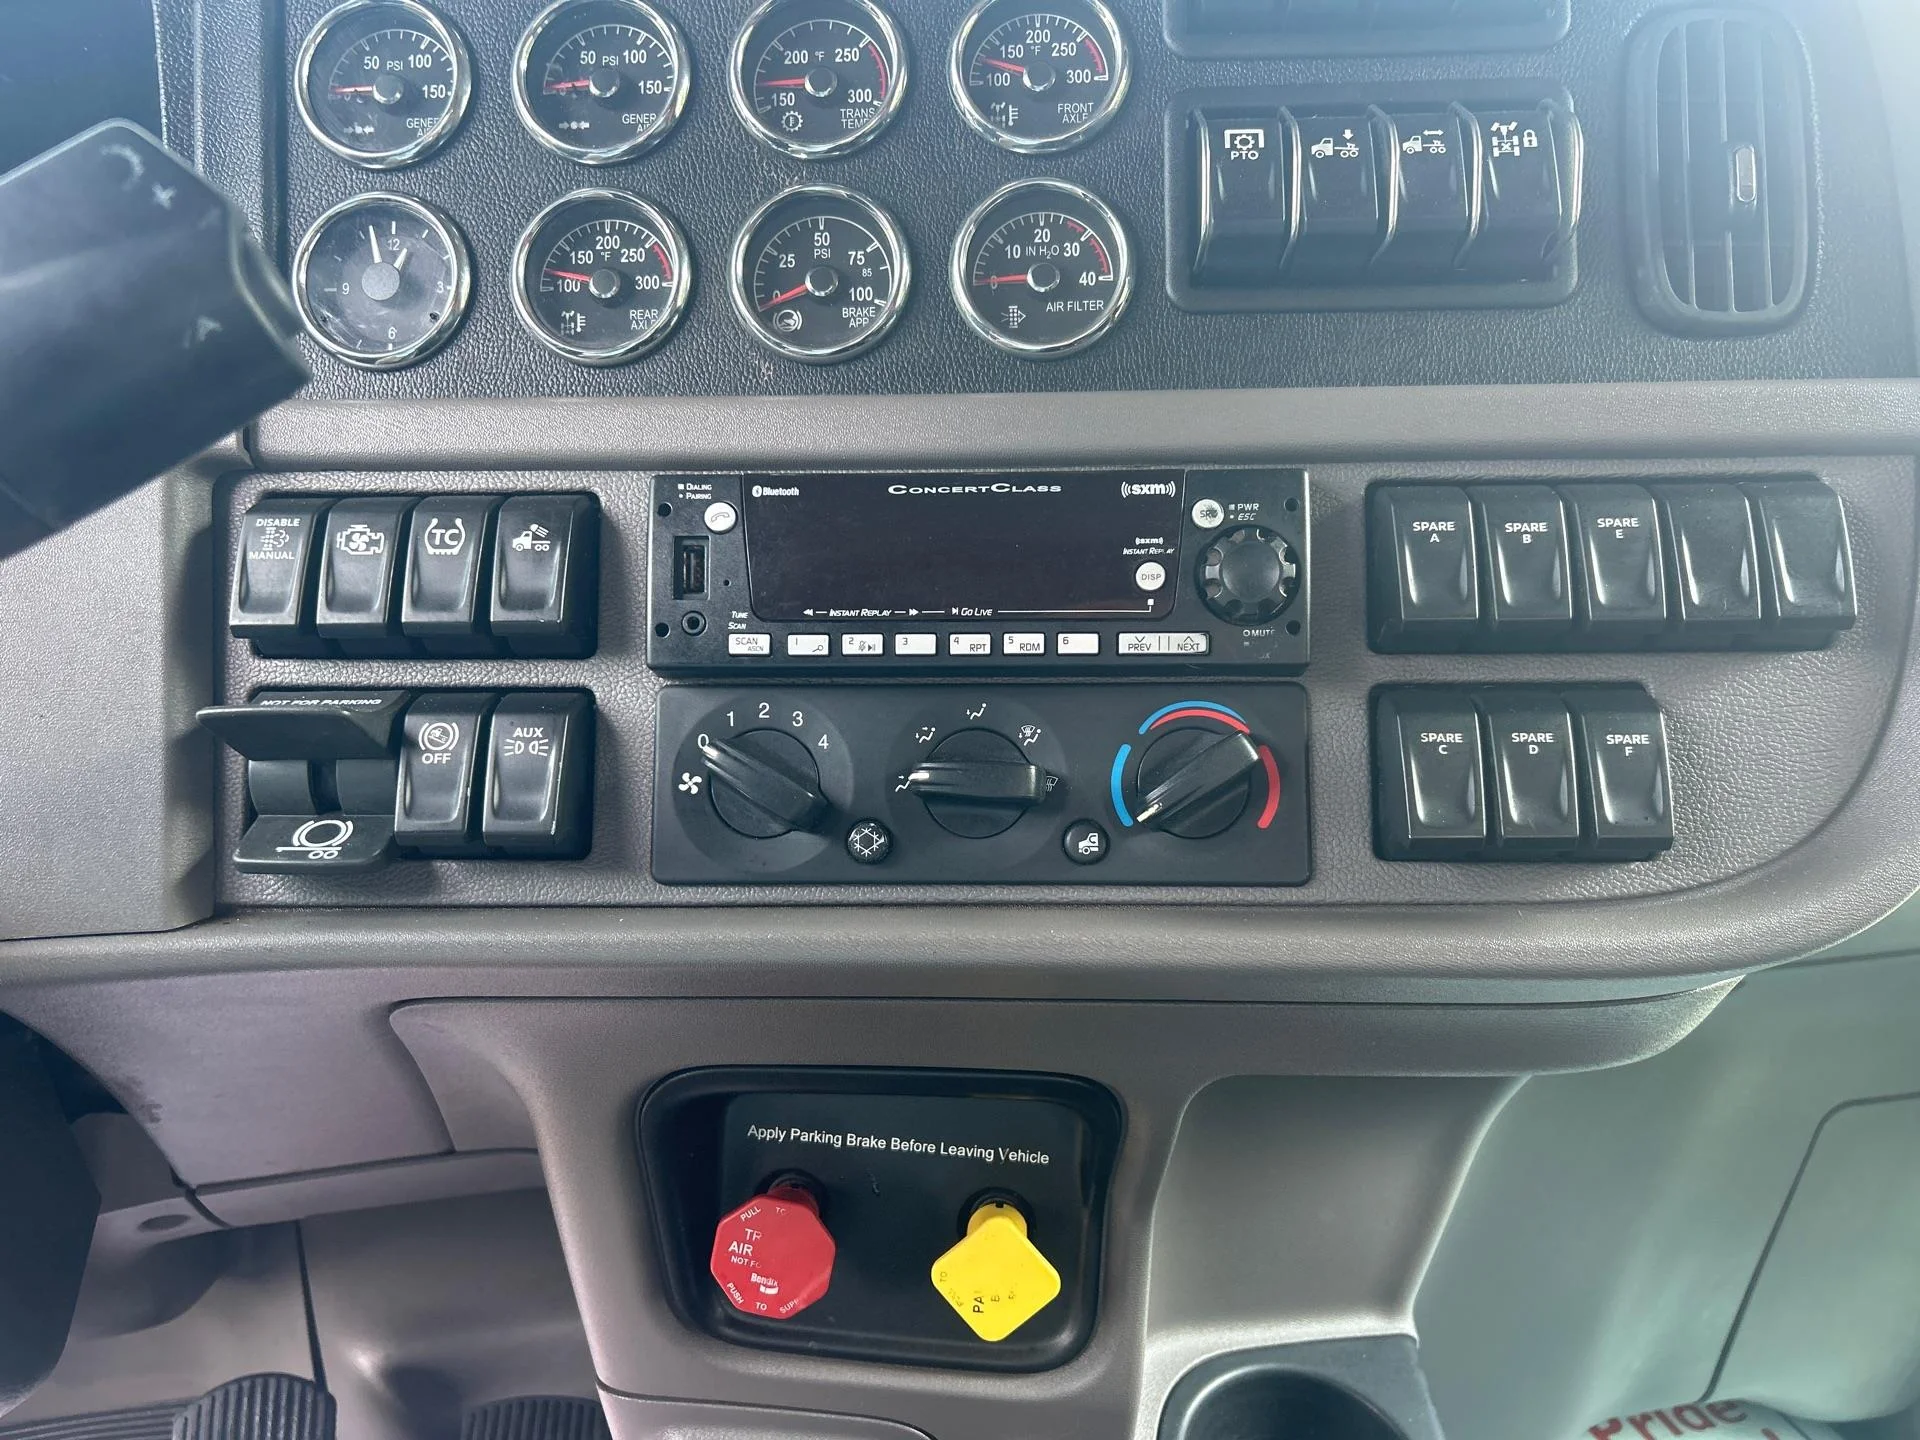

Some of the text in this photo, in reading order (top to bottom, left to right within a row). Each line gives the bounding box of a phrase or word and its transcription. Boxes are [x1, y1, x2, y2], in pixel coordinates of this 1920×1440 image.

[1026, 29, 1051, 44] 200
[835, 47, 860, 63] 250
[1000, 44, 1024, 59] 150
[1051, 42, 1077, 57] 250
[363, 55, 380, 70] 50
[408, 54, 432, 69] 100
[580, 50, 597, 65] 50
[602, 55, 619, 66] PSI
[623, 49, 647, 64] 100
[784, 50, 808, 65] 200
[386, 60, 404, 71] PSI
[986, 72, 1011, 87] 100
[1066, 69, 1092, 84] 300
[422, 84, 446, 99] 150
[638, 80, 662, 95] 150
[771, 92, 796, 107] 150
[847, 88, 872, 103] 300
[840, 108, 876, 119] TRANS
[1057, 102, 1094, 114] FRONT
[1230, 150, 1259, 160] PTO
[814, 232, 831, 247] 50
[1033, 228, 1051, 243] 20
[387, 238, 401, 252] 12
[595, 235, 620, 250] 200
[620, 248, 646, 263] 250
[813, 248, 831, 259] PSI
[1004, 244, 1021, 259] 10
[1025, 246, 1036, 256] IN
[1063, 242, 1080, 257] 30
[570, 250, 594, 265] 150
[779, 254, 796, 268] 25
[848, 251, 865, 266] 75
[862, 268, 873, 277] 85
[635, 275, 660, 290] 300
[1079, 271, 1096, 287] 40
[341, 284, 350, 295] 9
[436, 282, 444, 294] 3
[557, 279, 581, 293] 100
[848, 286, 874, 302] 100
[842, 306, 876, 318] BRAKE
[1045, 300, 1104, 312] AIR FILTER
[629, 309, 659, 320] REAR
[848, 317, 870, 328] APP
[387, 327, 396, 340] 6
[763, 486, 799, 496] Bluetooth
[1237, 503, 1260, 511] PWR
[255, 517, 301, 528] DISABLE
[1237, 513, 1257, 521] ESC
[1597, 517, 1640, 528] SPARE
[1412, 521, 1456, 532] SPARE
[1504, 521, 1549, 533] SPARE
[431, 529, 458, 545] TC
[1430, 532, 1440, 543] A
[1522, 533, 1532, 544] B
[1616, 529, 1625, 539] E
[249, 551, 295, 560] MANUAL
[1141, 573, 1161, 581] DISP
[735, 637, 758, 645] SCAN
[848, 637, 854, 645] 2
[953, 637, 959, 645] 4
[1008, 636, 1014, 645] 5
[1063, 636, 1069, 645] 6
[969, 644, 987, 652] RPT
[1019, 643, 1041, 652] RDM
[1128, 643, 1152, 652] PREV
[1177, 643, 1201, 652] NEXT
[758, 702, 770, 719] 2
[726, 711, 735, 727] 1
[792, 711, 804, 727] 3
[513, 727, 544, 738] AUX
[1420, 732, 1463, 743] SPARE
[1511, 732, 1555, 743] SPARE
[697, 733, 710, 750] 0
[817, 734, 829, 750] 4
[1606, 734, 1650, 745] SPARE
[1438, 744, 1448, 755] C
[1528, 744, 1539, 755] D
[1625, 746, 1633, 757] F
[421, 753, 452, 765] OFF
[747, 1124, 1050, 1164] Apply Parking Brake Before Leaving Vehicle
[740, 1206, 762, 1222] PULL
[728, 1241, 753, 1257] AIR
[730, 1255, 748, 1266] NOT
[726, 1282, 745, 1304] PUSH
[755, 1302, 768, 1311] TO
